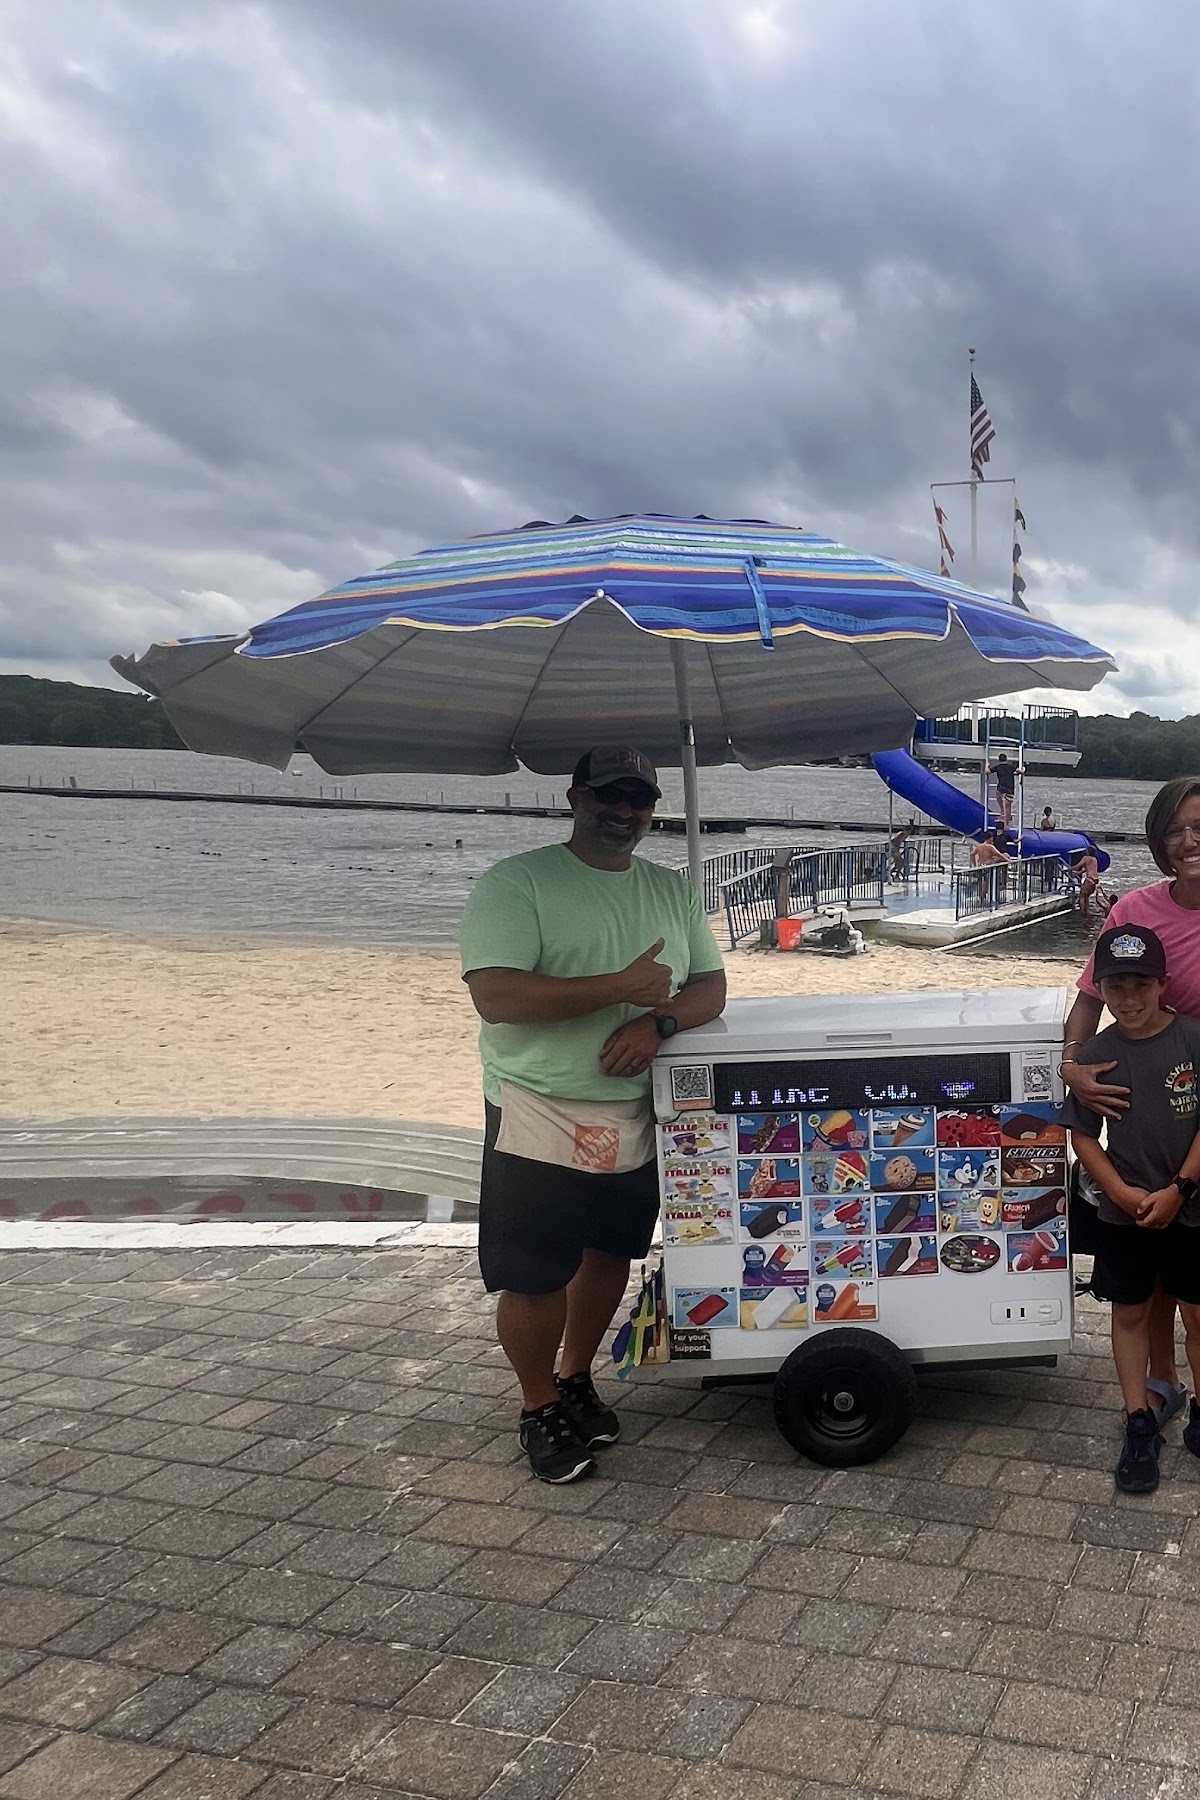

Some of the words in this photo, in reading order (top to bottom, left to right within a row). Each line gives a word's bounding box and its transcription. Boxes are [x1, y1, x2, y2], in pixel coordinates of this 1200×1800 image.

[662, 1124, 698, 1133] ITALIA
[1006, 1148, 1060, 1158] SNICKERS
[665, 1169, 700, 1177] ITALIA
[665, 1212, 702, 1220] ITALIA
[673, 1333, 687, 1341] For
[688, 1334, 707, 1342] your
[674, 1345, 707, 1353] Support
